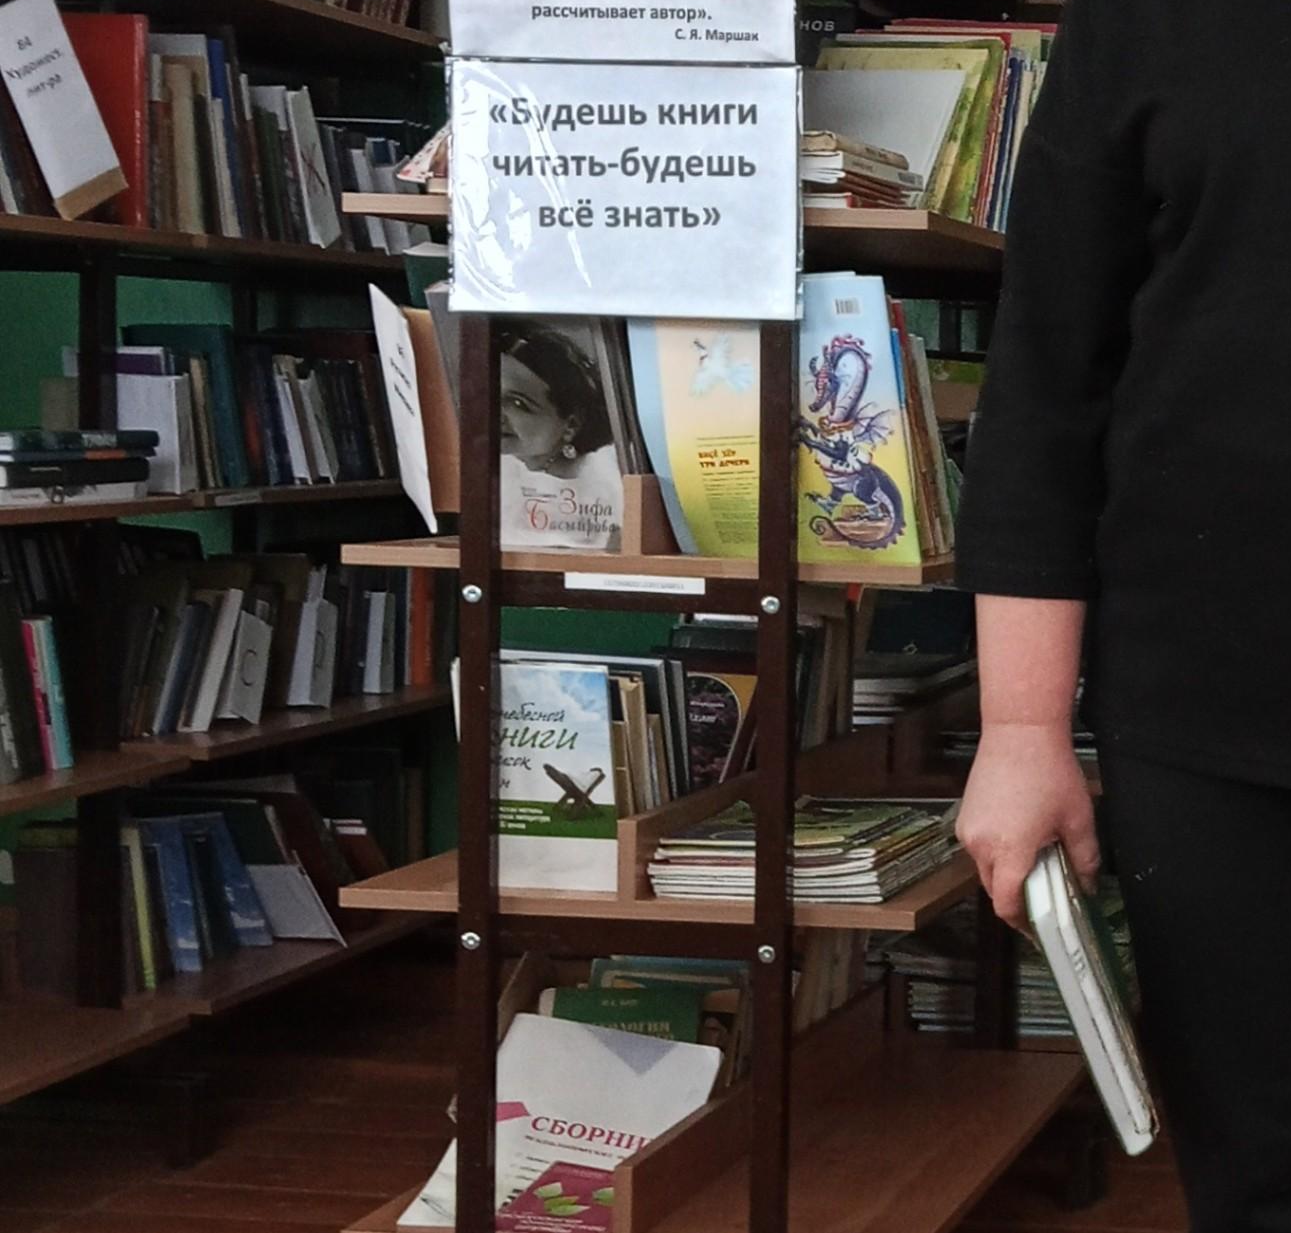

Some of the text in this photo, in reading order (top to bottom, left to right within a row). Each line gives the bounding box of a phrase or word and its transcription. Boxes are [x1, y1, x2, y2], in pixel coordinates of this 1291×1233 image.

[531, 4, 713, 23] рассчитывает автор».
[689, 28, 703, 41] Я.
[705, 29, 759, 43] Маршак
[488, 98, 758, 132] «Будешь книги
[492, 147, 757, 184] читать-будешь
[538, 199, 722, 228] всё знать»
[498, 726, 579, 751] ниги
